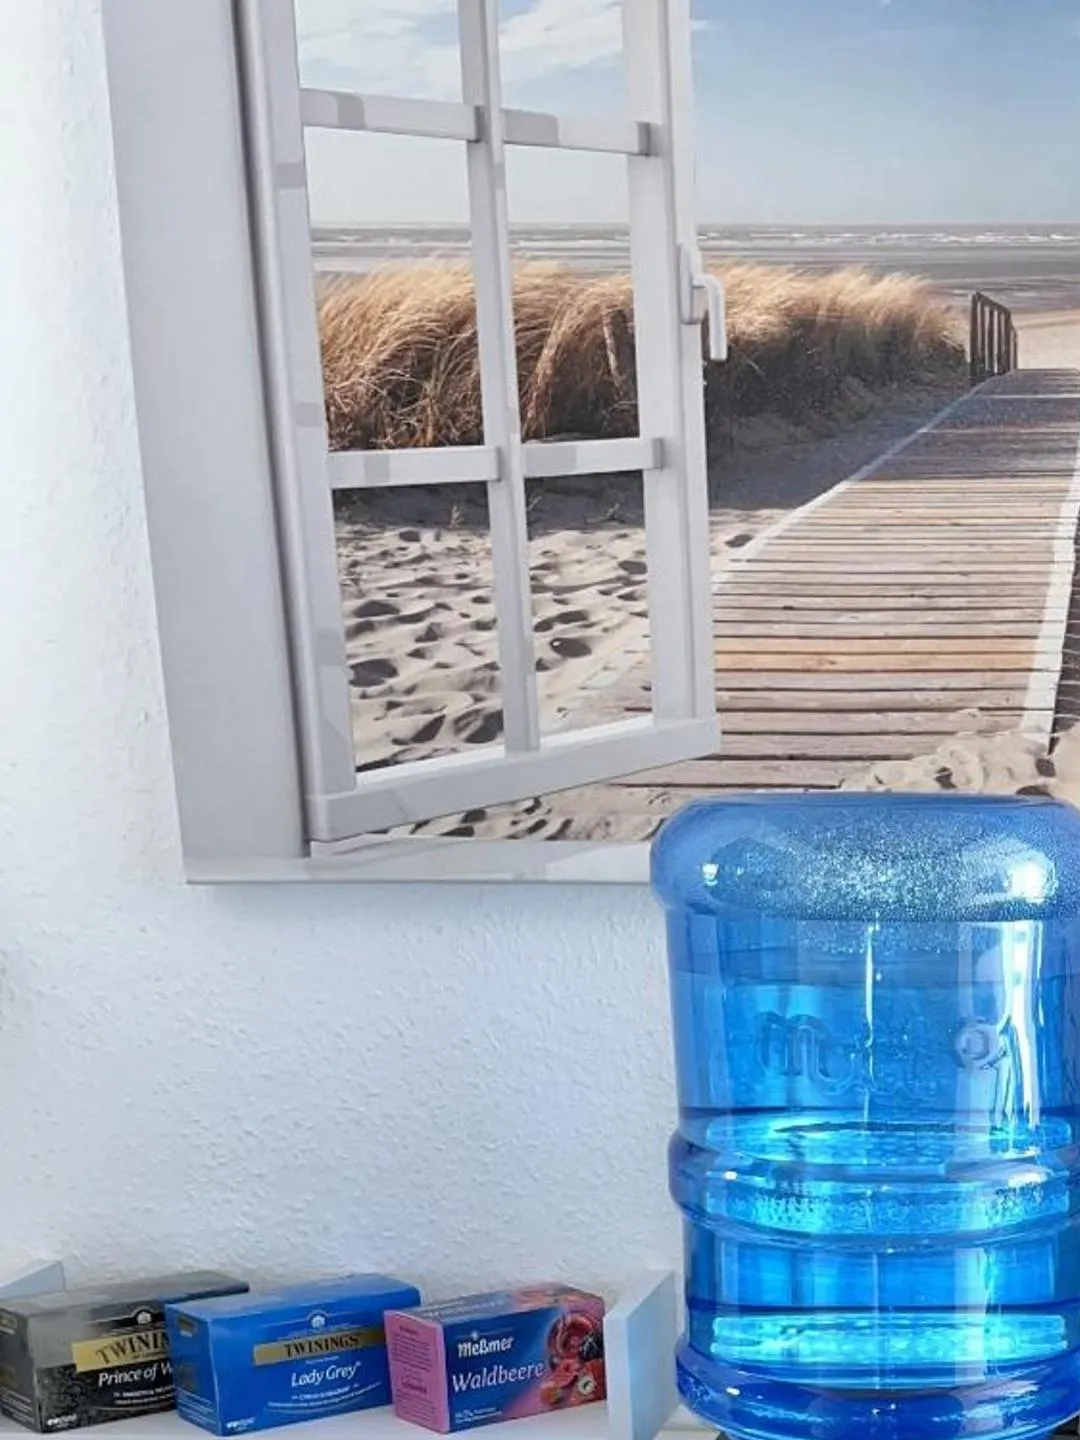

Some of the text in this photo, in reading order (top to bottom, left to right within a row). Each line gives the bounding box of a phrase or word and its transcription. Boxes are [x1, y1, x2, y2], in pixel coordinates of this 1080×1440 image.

[284, 1334, 359, 1358] TWININGS
[457, 1336, 514, 1358] Meßmer
[99, 1369, 141, 1388] Prince
[143, 1364, 158, 1381] of
[291, 1369, 324, 1388] Lady
[452, 1362, 544, 1393] Waldbeere
